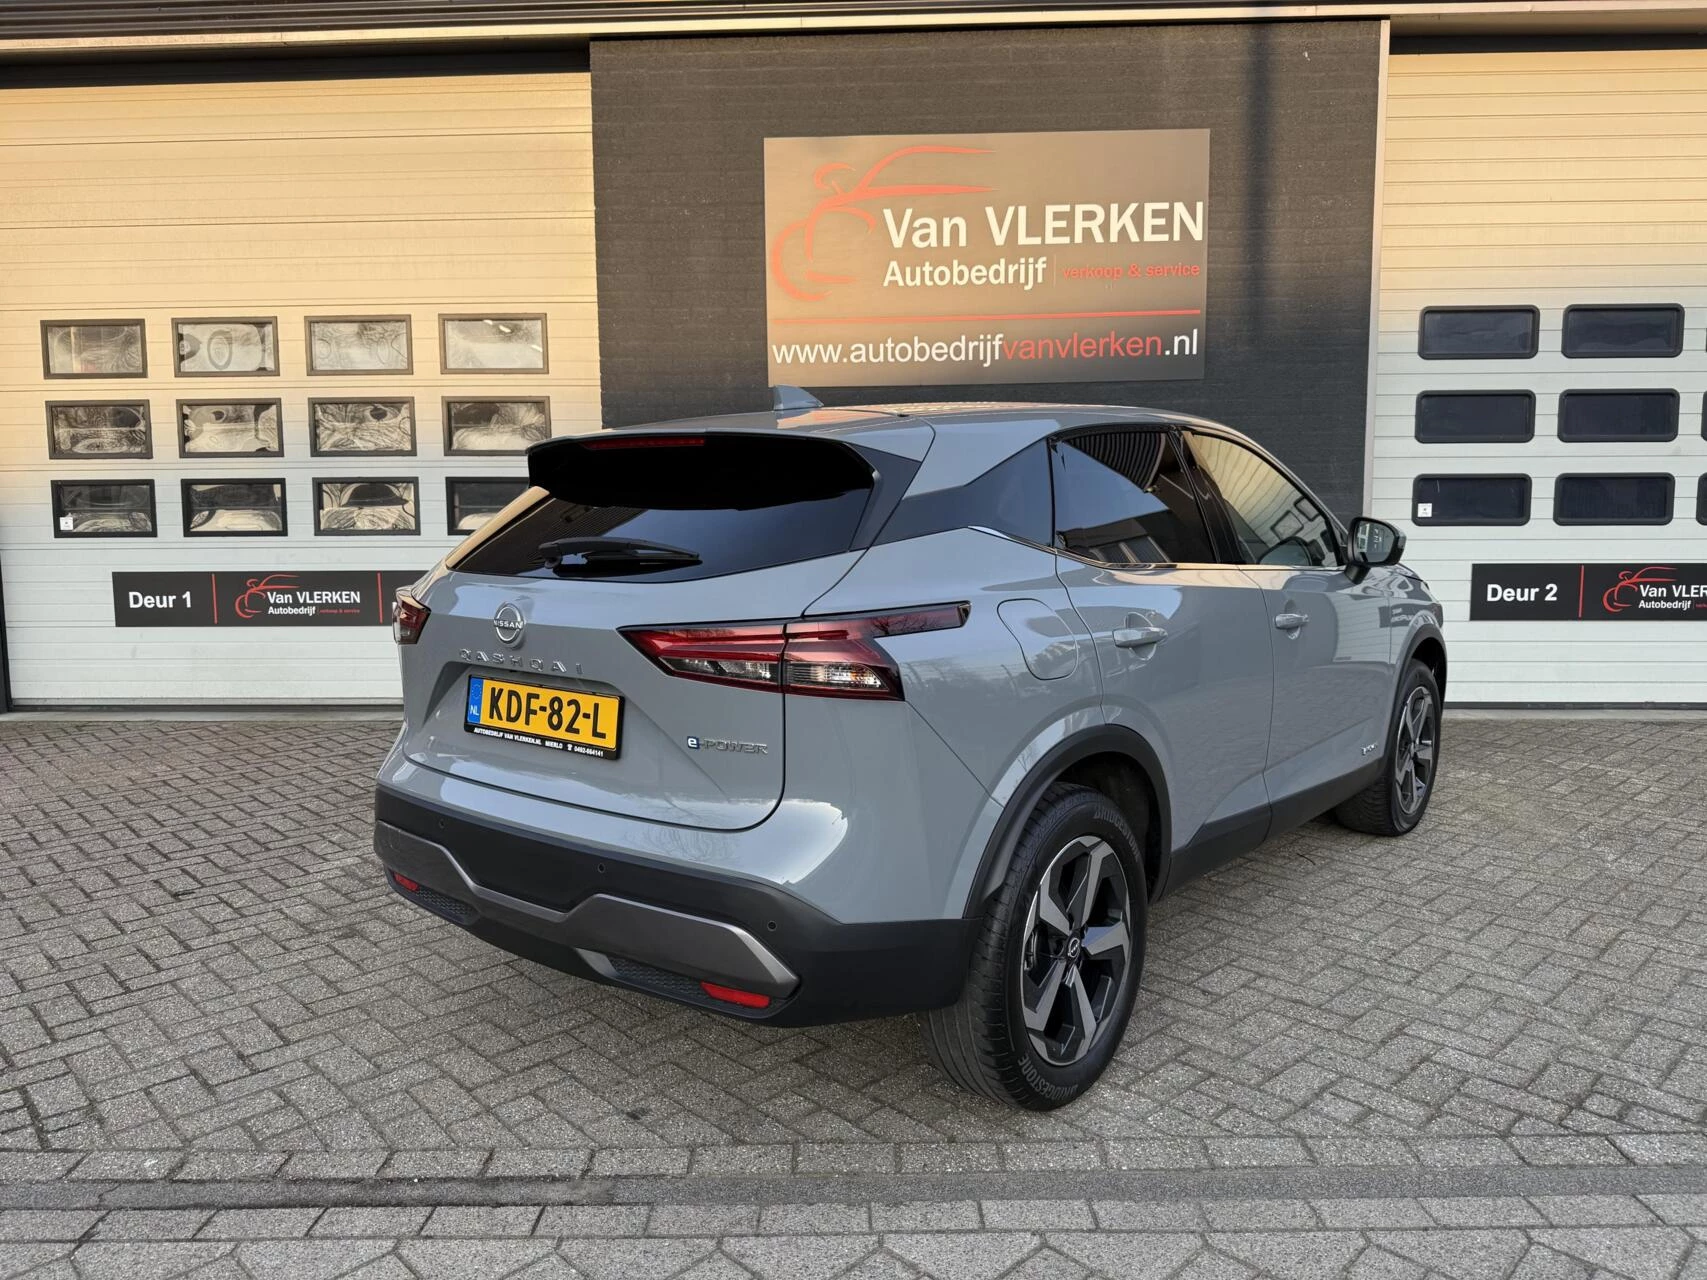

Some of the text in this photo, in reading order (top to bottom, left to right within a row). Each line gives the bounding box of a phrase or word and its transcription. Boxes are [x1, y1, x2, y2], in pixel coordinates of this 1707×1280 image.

[883, 201, 1204, 248] Van VLERKEN
[883, 257, 1200, 290] Autobedrijf verkoop & service
[771, 329, 1199, 367] www.autobedrijfvanvlerken.nl
[128, 591, 192, 608] Deur 1
[267, 591, 360, 604] Van VLERKEN
[1487, 583, 1558, 602] Deur 2
[1640, 585, 1667, 597] Van
[268, 606, 316, 616] Autobedrijf
[1638, 600, 1691, 611] Autobedrijf
[494, 620, 523, 629] NISSAN
[460, 648, 583, 675] QASHQAI
[469, 705, 480, 716] NL
[489, 687, 607, 739] KDF-82-L
